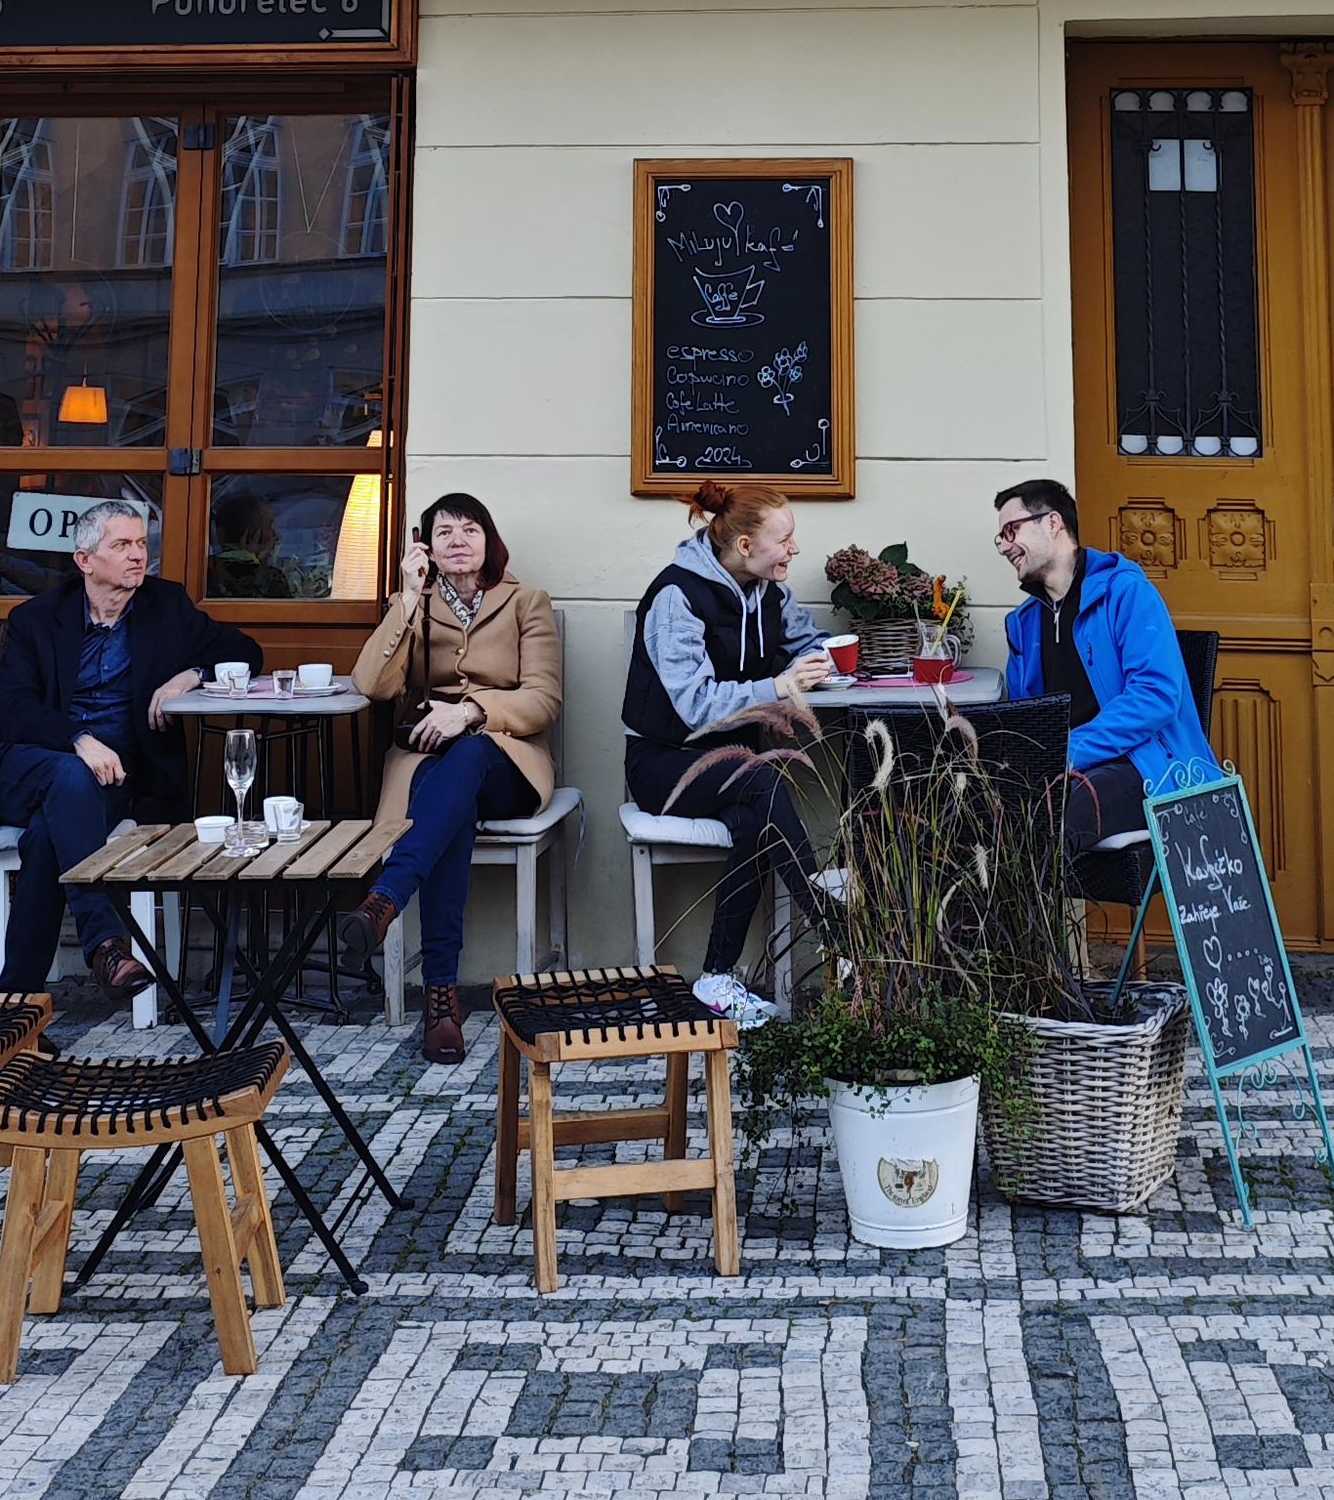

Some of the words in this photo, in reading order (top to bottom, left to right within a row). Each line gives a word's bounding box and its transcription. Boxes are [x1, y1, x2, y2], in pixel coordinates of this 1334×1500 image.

[667, 345, 754, 372] espresso
[667, 412, 749, 434] Americano
[28, 508, 79, 538] OP
